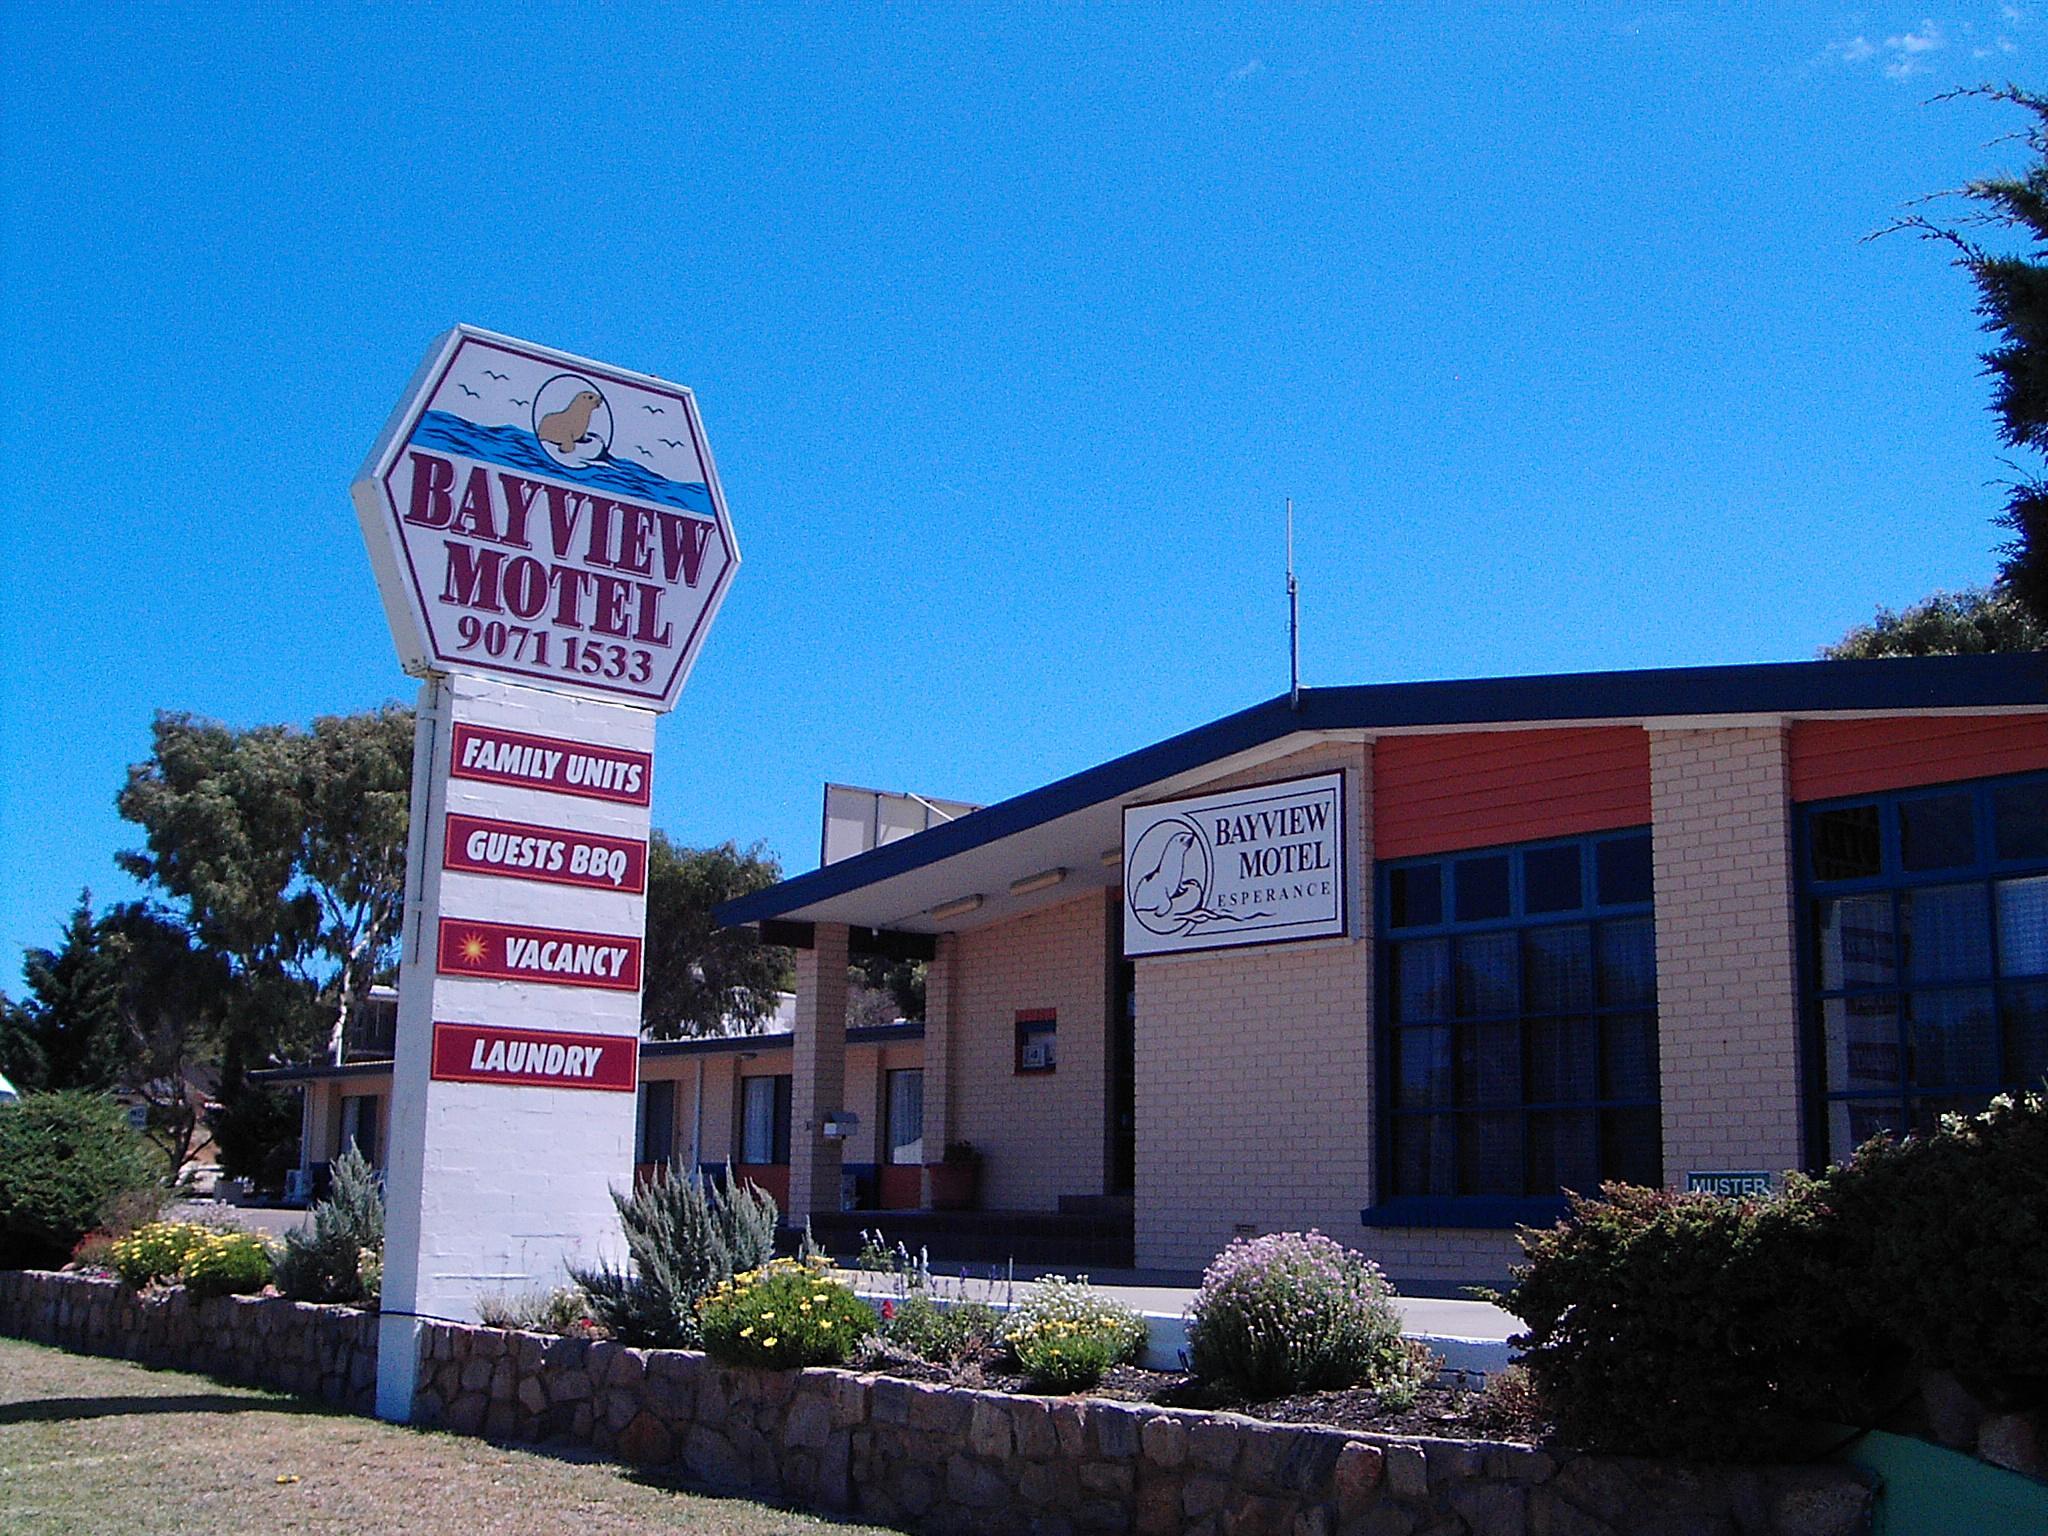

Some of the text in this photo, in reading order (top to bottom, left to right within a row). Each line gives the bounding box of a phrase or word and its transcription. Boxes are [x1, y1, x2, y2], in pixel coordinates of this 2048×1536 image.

[404, 452, 716, 588] BAYVIEW
[439, 540, 673, 648] MOTEL
[456, 615, 654, 684] 9071 1533
[462, 737, 643, 794] FAMILY UNITS
[1216, 801, 1331, 846] BAYVIEW
[466, 830, 627, 886] GUESTS BBQ
[1239, 841, 1331, 879] MOTEL
[1217, 881, 1331, 908] ESPERANCE
[504, 937, 628, 978] VACANCY
[470, 1038, 602, 1078] LAUNDRY
[1692, 1178, 1768, 1195] MUSTER
